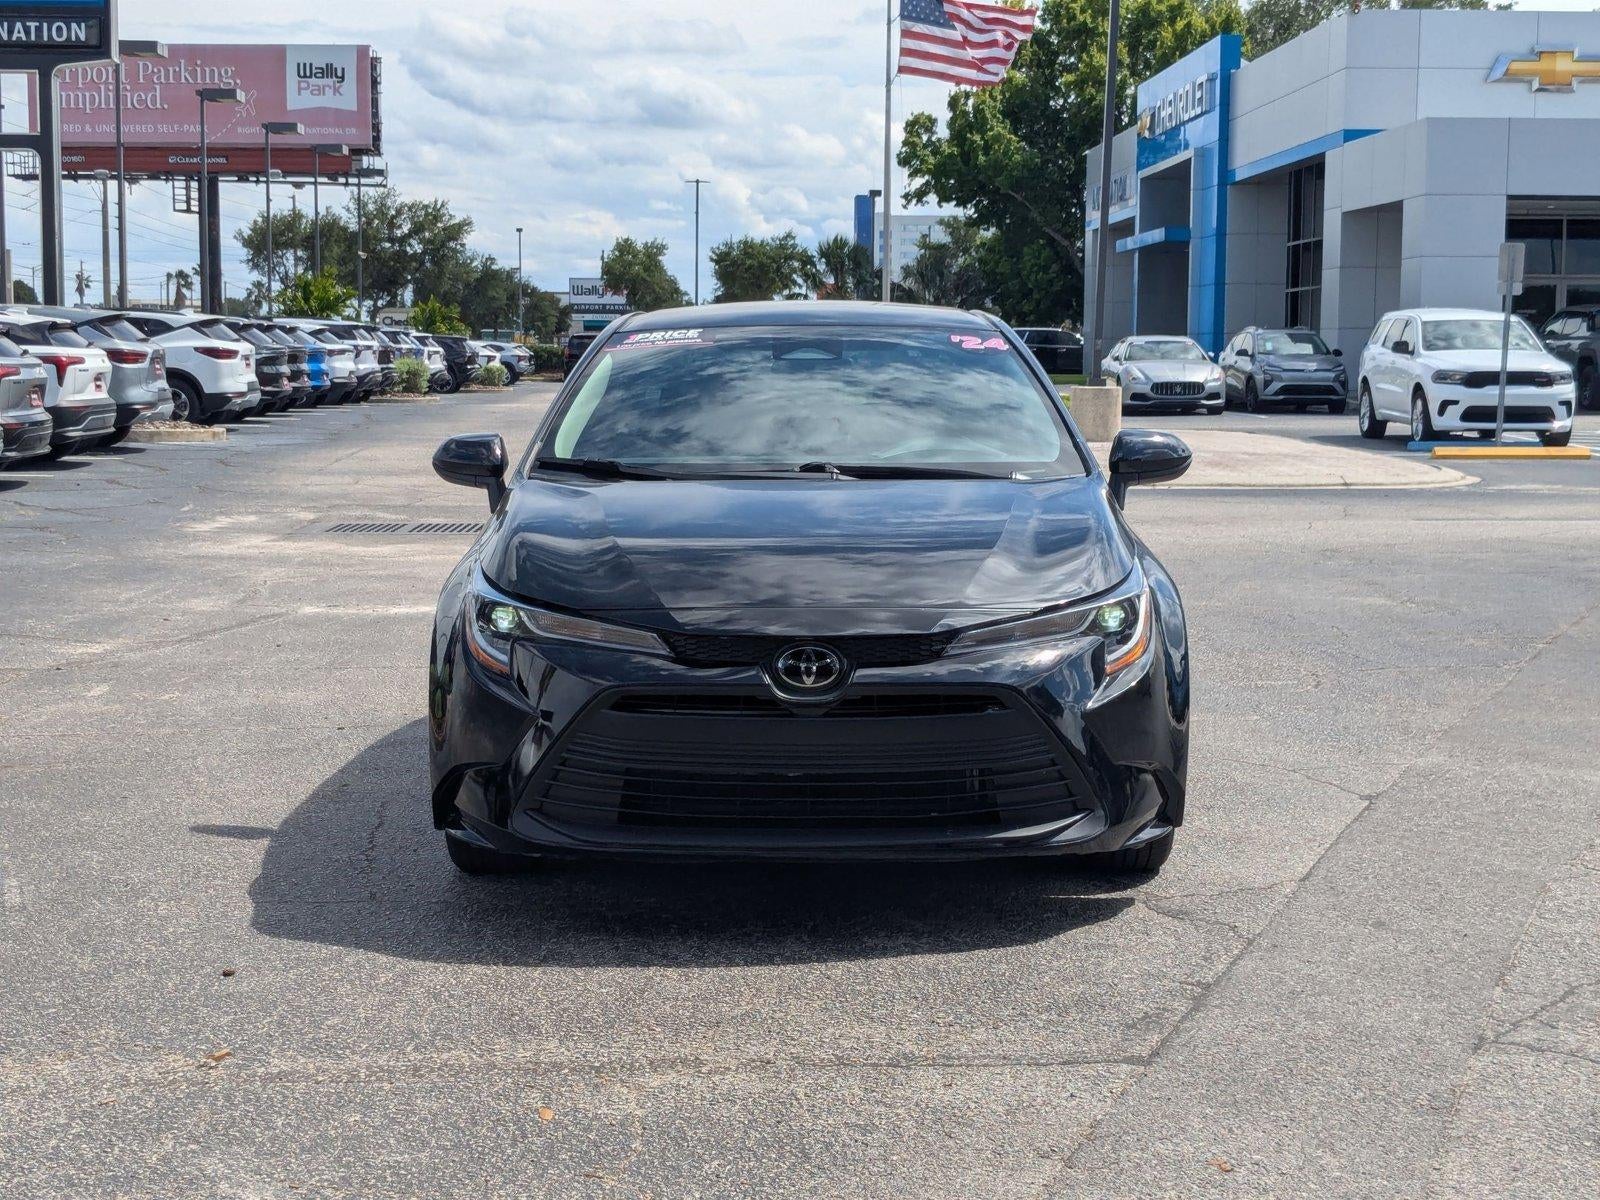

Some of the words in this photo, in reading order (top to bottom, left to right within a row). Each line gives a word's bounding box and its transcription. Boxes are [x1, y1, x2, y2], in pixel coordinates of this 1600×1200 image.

[0, 21, 86, 42] NATION
[137, 60, 241, 89] Parking,
[297, 62, 346, 84] Wally
[297, 80, 344, 96] Park
[1154, 73, 1218, 136] CHEVROLET
[85, 124, 92, 133] &
[95, 124, 154, 133] UNCVERED
[572, 285, 605, 298] Wally
